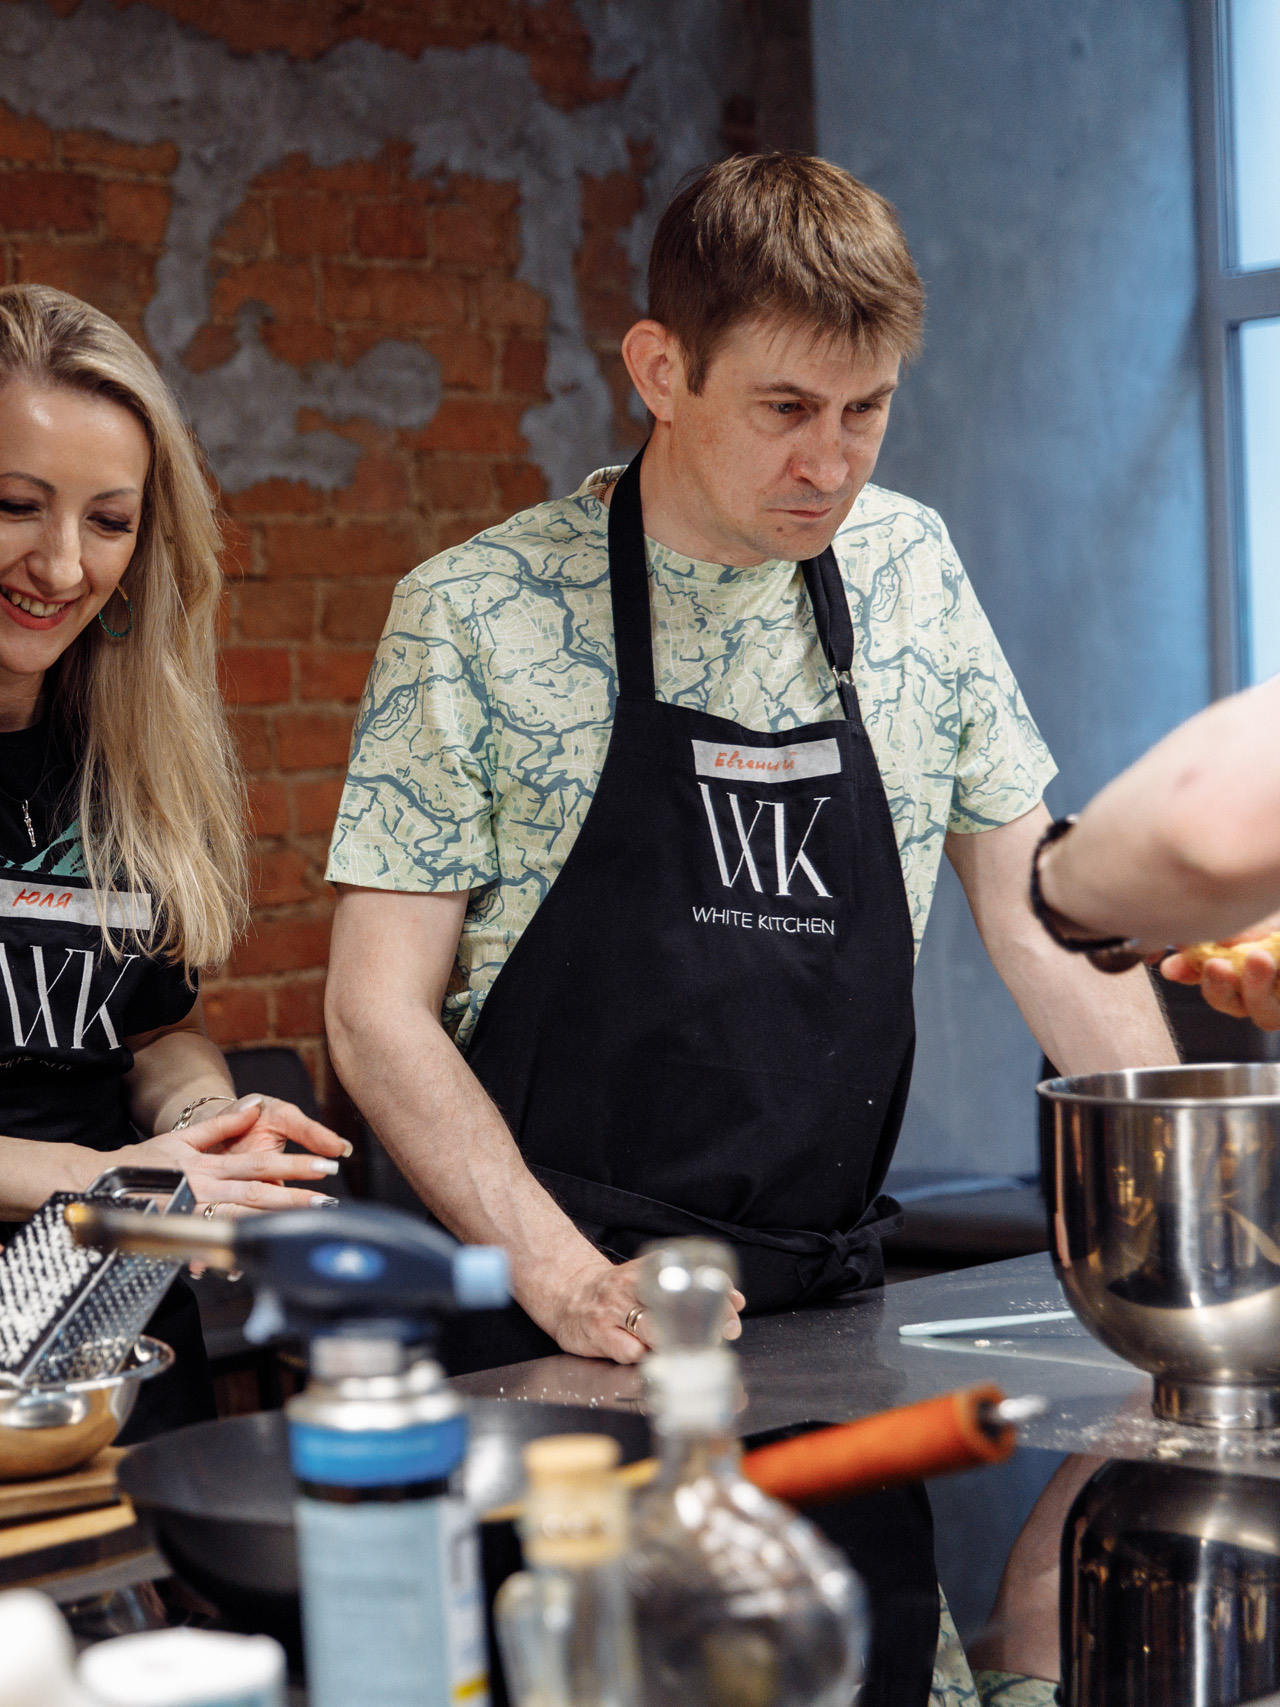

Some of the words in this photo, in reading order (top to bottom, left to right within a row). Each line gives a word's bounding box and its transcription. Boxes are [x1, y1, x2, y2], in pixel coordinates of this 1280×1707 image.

[697, 781, 833, 897] WK
[692, 906, 753, 929] WHITE
[758, 914, 836, 936] KITCHEN
